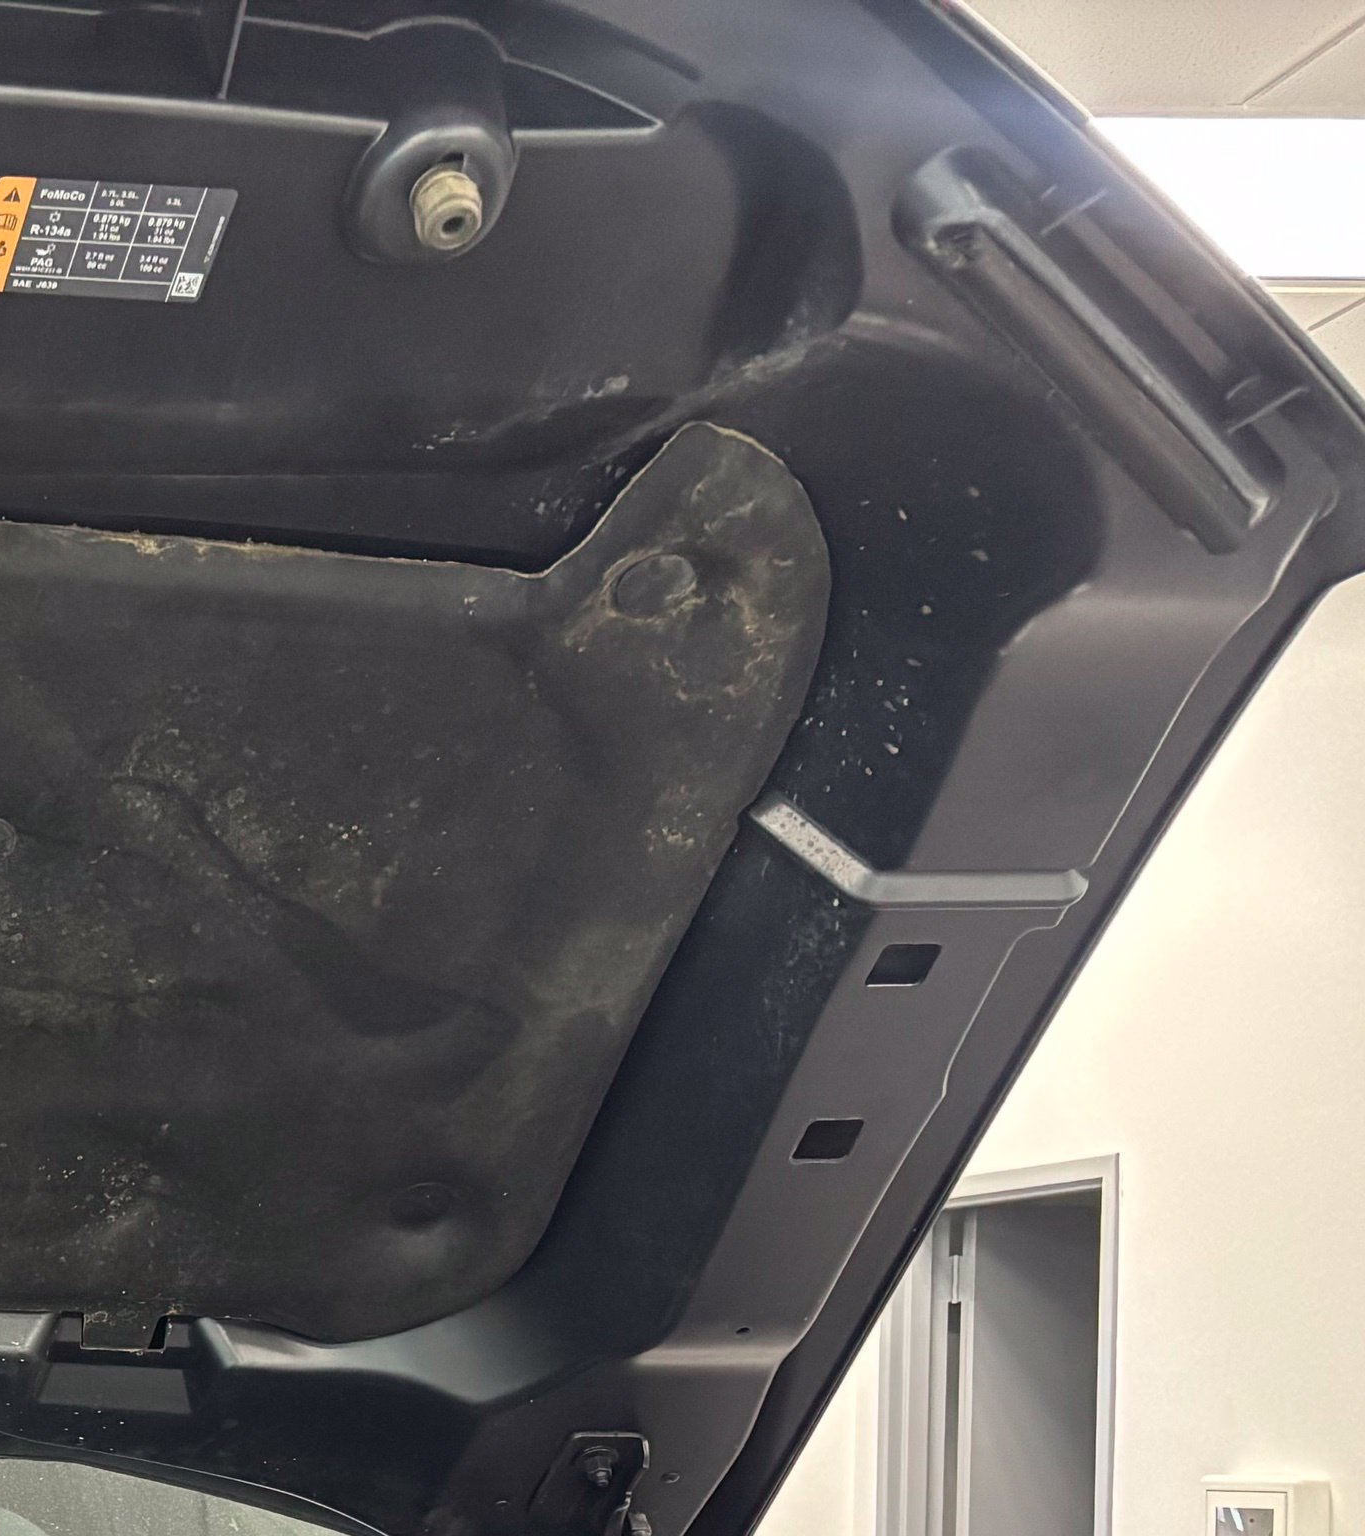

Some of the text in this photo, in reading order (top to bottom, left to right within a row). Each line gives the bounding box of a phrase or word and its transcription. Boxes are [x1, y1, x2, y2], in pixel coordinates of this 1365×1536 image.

[40, 189, 86, 201] FoMoCo
[30, 224, 71, 237] R-134a
[30, 257, 53, 267] PAG
